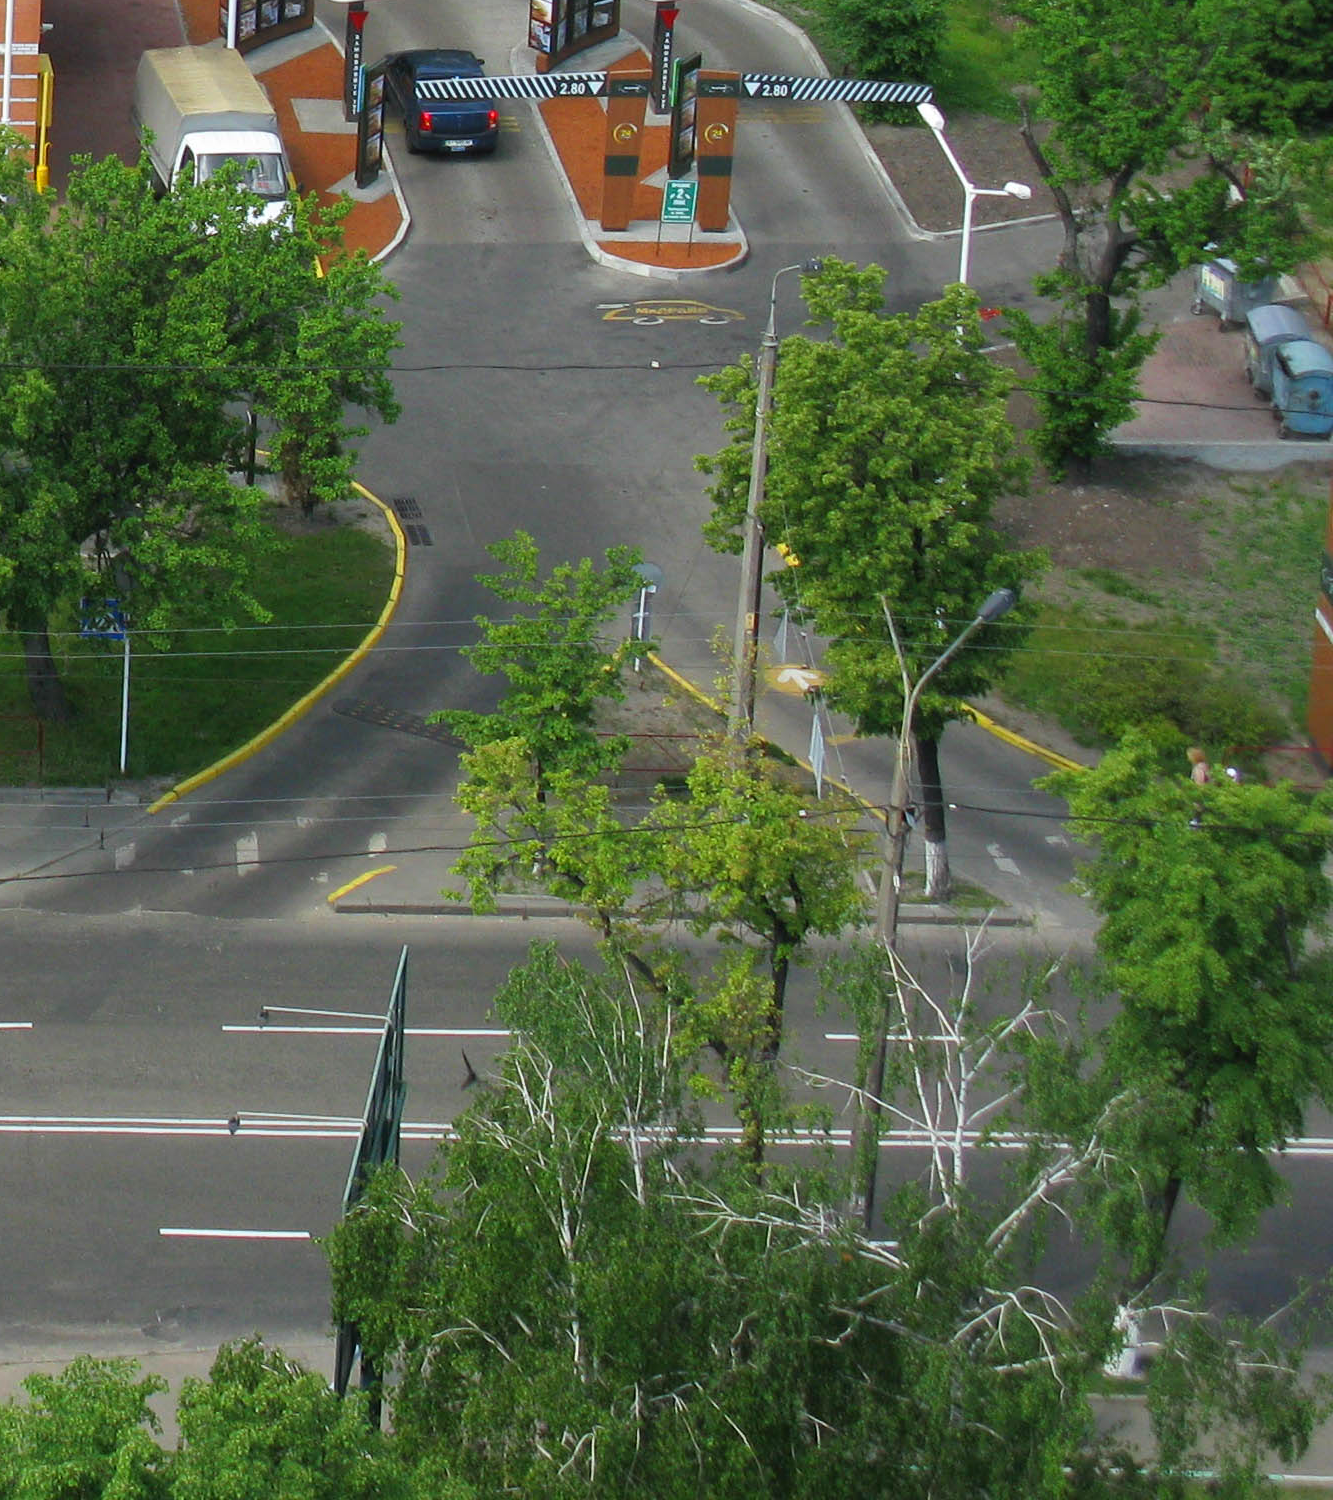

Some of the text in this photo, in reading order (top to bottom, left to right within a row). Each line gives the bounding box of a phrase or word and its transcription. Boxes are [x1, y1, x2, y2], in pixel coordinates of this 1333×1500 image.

[559, 82, 586, 95] 2.80
[761, 84, 788, 97] 2.80
[676, 188, 685, 199] 2
